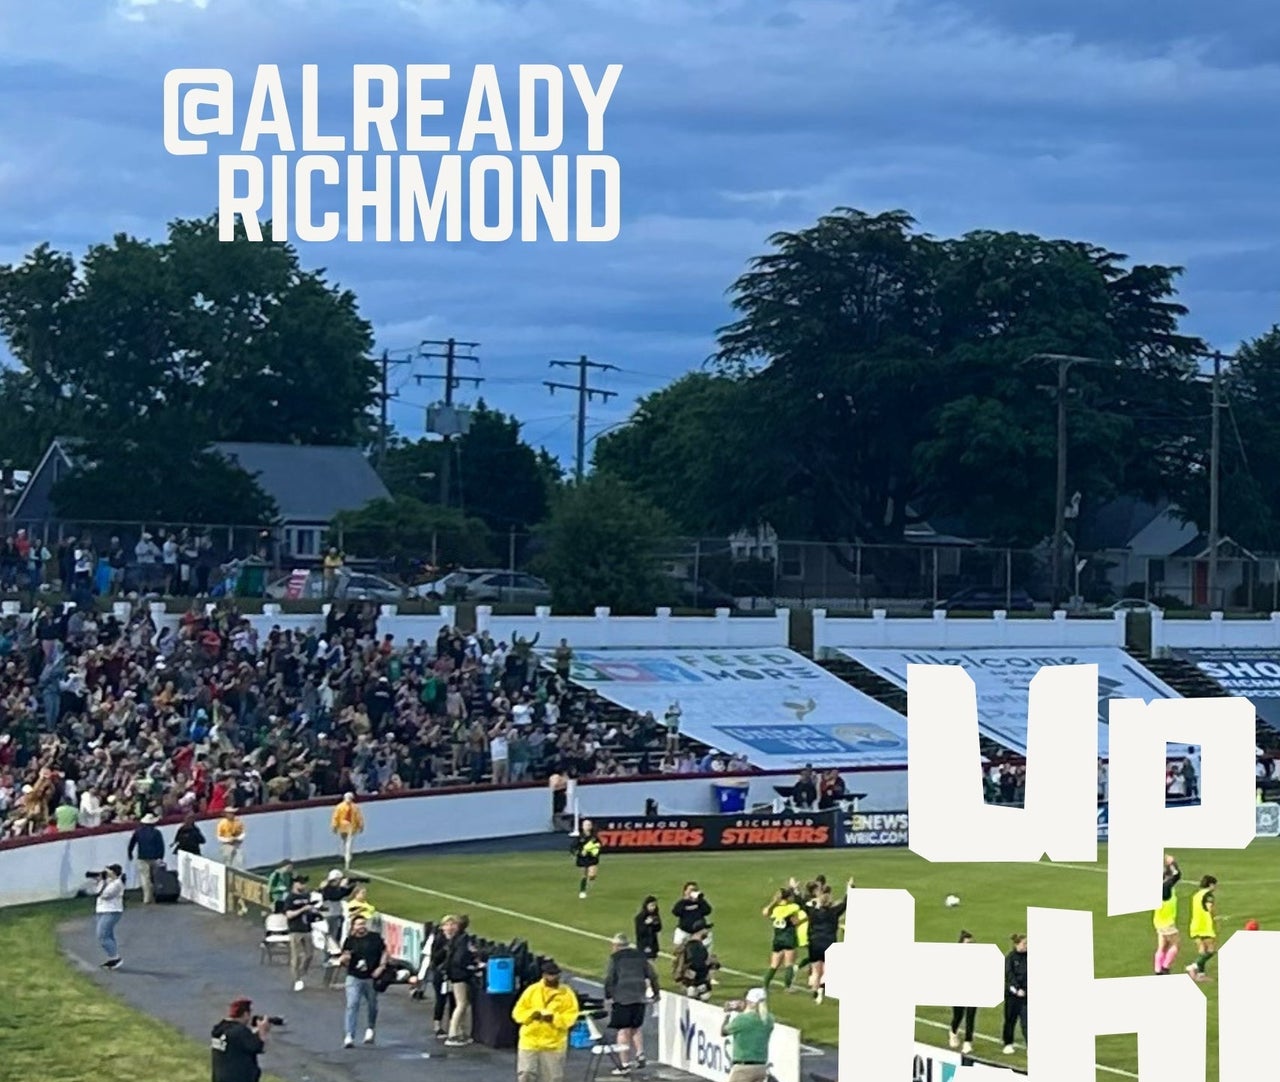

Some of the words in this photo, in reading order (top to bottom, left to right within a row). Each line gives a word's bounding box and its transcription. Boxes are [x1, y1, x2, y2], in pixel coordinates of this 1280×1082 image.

[676, 653, 793, 666] FEED
[702, 666, 821, 682] MORE
[720, 826, 830, 845] STRIKERS
[697, 1029, 723, 1072] Bon
